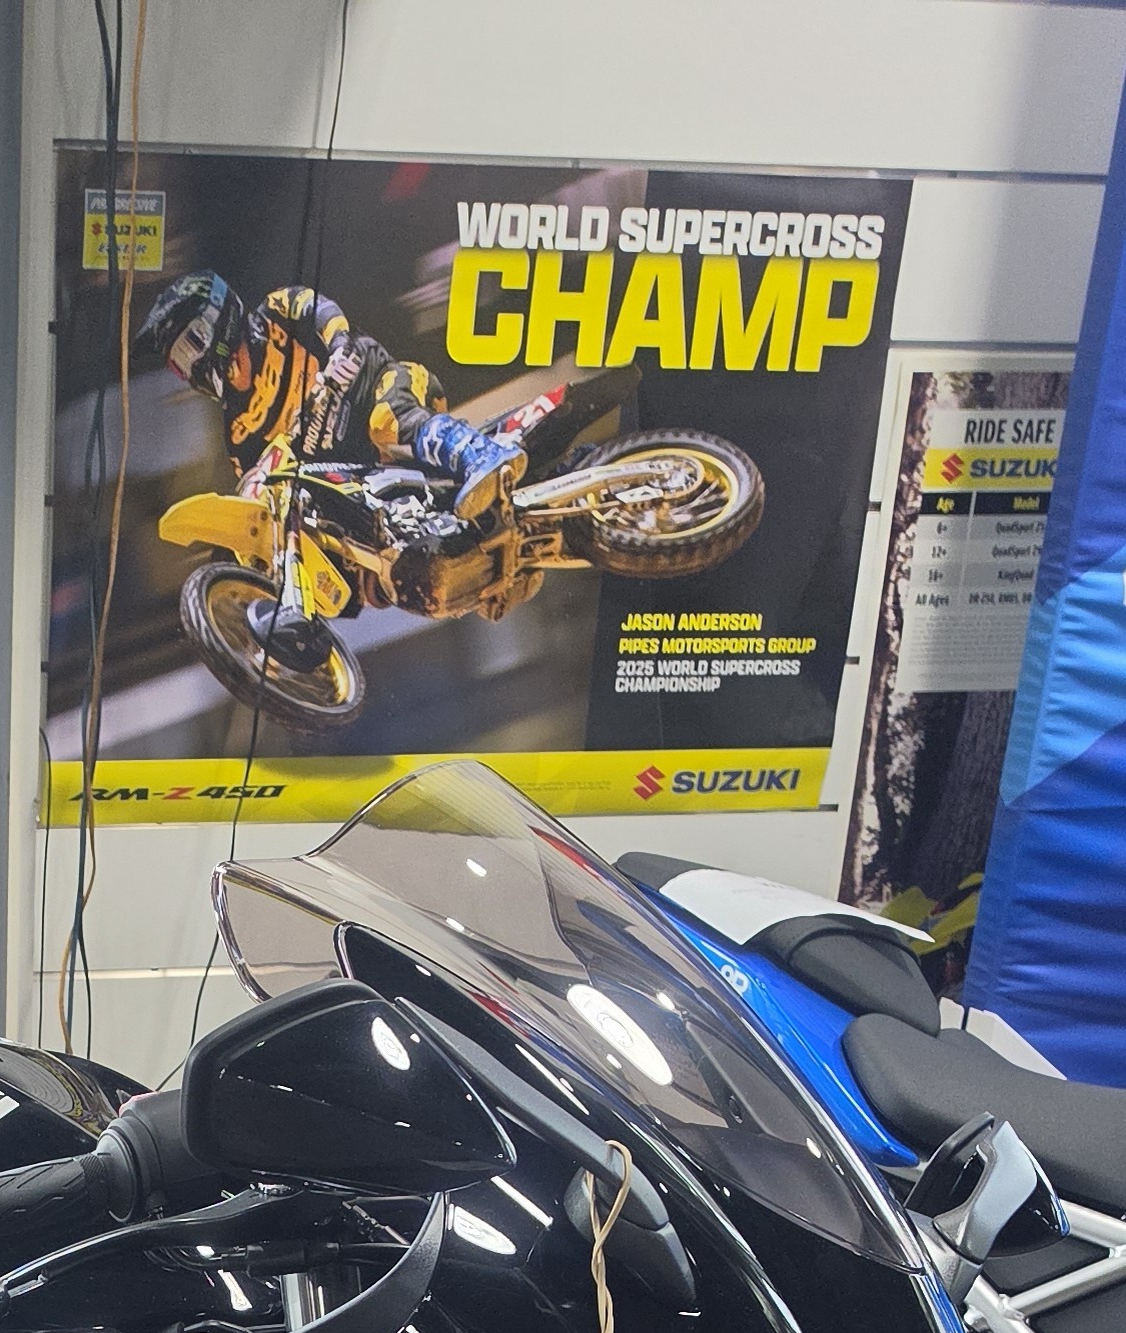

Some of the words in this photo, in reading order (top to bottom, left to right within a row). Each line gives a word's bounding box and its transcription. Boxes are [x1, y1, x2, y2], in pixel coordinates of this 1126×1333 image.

[457, 201, 609, 252] WORLD
[618, 207, 885, 260] SUPERCROSS
[446, 250, 880, 373] CHAMP
[964, 418, 1006, 445] RIDE
[1011, 418, 1057, 445] SAFE
[621, 613, 675, 631] JASON
[677, 613, 763, 631] ANDERSON
[619, 638, 660, 654] PIPES
[661, 637, 766, 654] MOTORSPORTS
[768, 637, 817, 654] GROUP
[617, 660, 654, 676] 2025
[658, 659, 708, 676] WORLD
[710, 659, 801, 676] SUPERCROSS
[615, 676, 721, 693] CHAMPIONSHIP
[671, 768, 801, 794] SUZUKI
